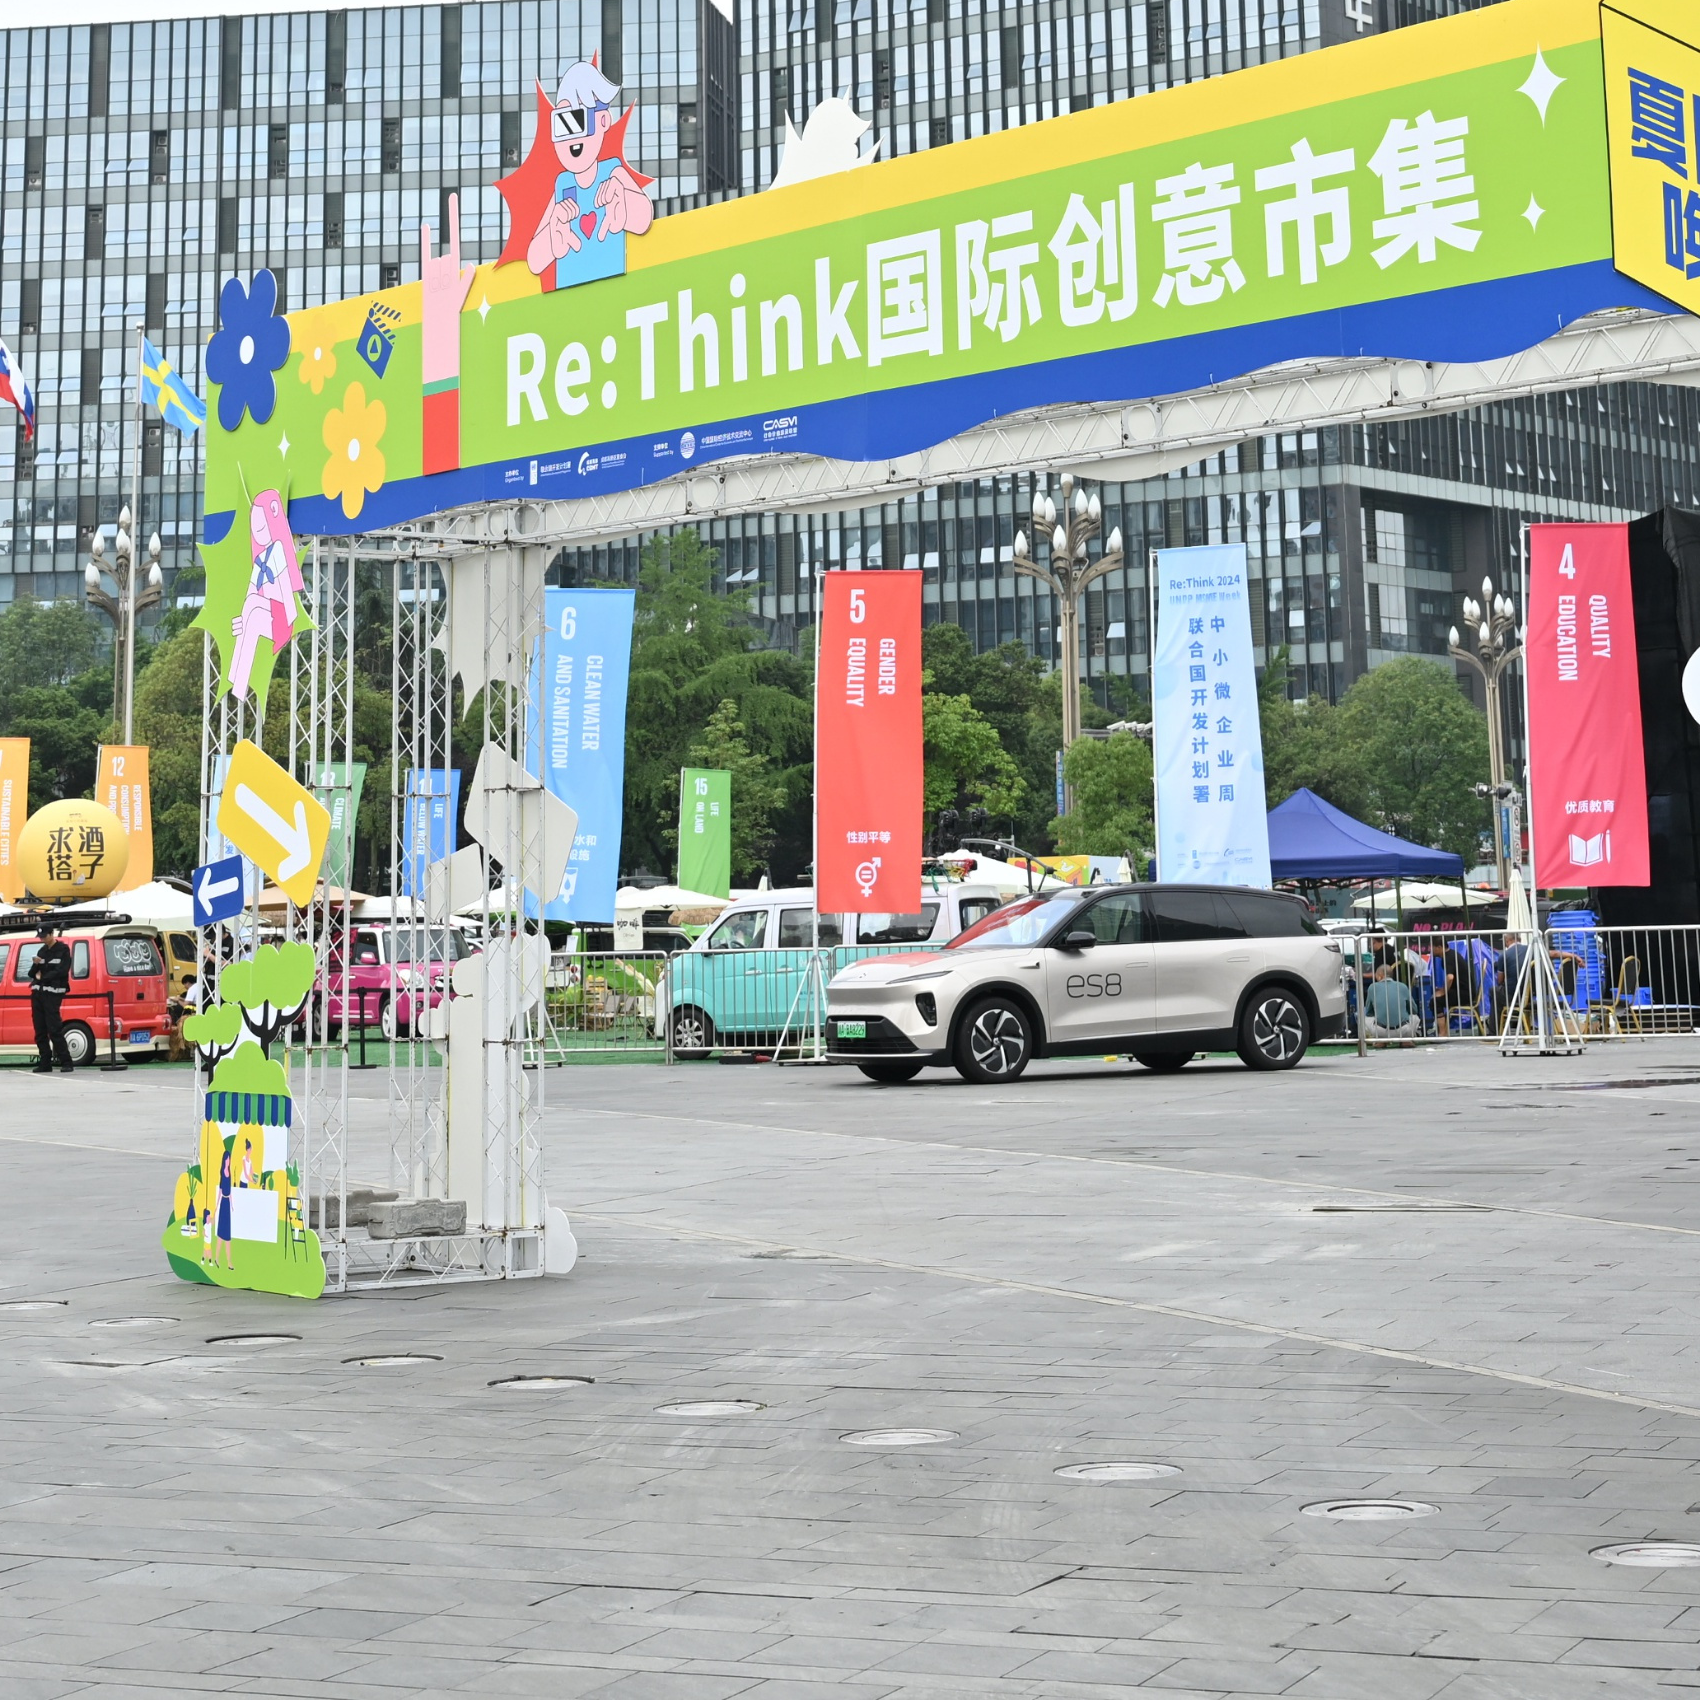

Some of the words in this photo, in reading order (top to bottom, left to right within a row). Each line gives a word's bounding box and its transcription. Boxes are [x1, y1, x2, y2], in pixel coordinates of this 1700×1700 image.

[1558, 543, 1576, 579] 4
[1169, 575, 1214, 590] Re:Think
[1217, 574, 1240, 586] 2024
[560, 606, 577, 640] 6
[849, 589, 865, 624] 5
[1557, 595, 1578, 681] EDUCATION
[1589, 594, 1611, 658] QUALITY
[555, 654, 573, 684] AND
[584, 655, 603, 700] CLEAN
[846, 638, 867, 708] EQUALITY
[878, 638, 896, 695] GENDER
[1188, 617, 1210, 803] 联合国开发计划署
[1210, 615, 1235, 802] 中小微企业周
[552, 686, 571, 769] SANITATION
[581, 703, 601, 751] WATER
[111, 756, 125, 777] 12
[694, 777, 708, 795] 15
[1, 779, 12, 832] SUSTAINABLE
[133, 784, 142, 831] RESPONSIBLE
[331, 797, 345, 830] CLIMATE
[433, 803, 444, 818] LIFE
[710, 802, 719, 817] LIFE
[1565, 800, 1615, 814] 优质教育
[0, 833, 10, 866] CITIES
[846, 831, 891, 844] 性别平等
